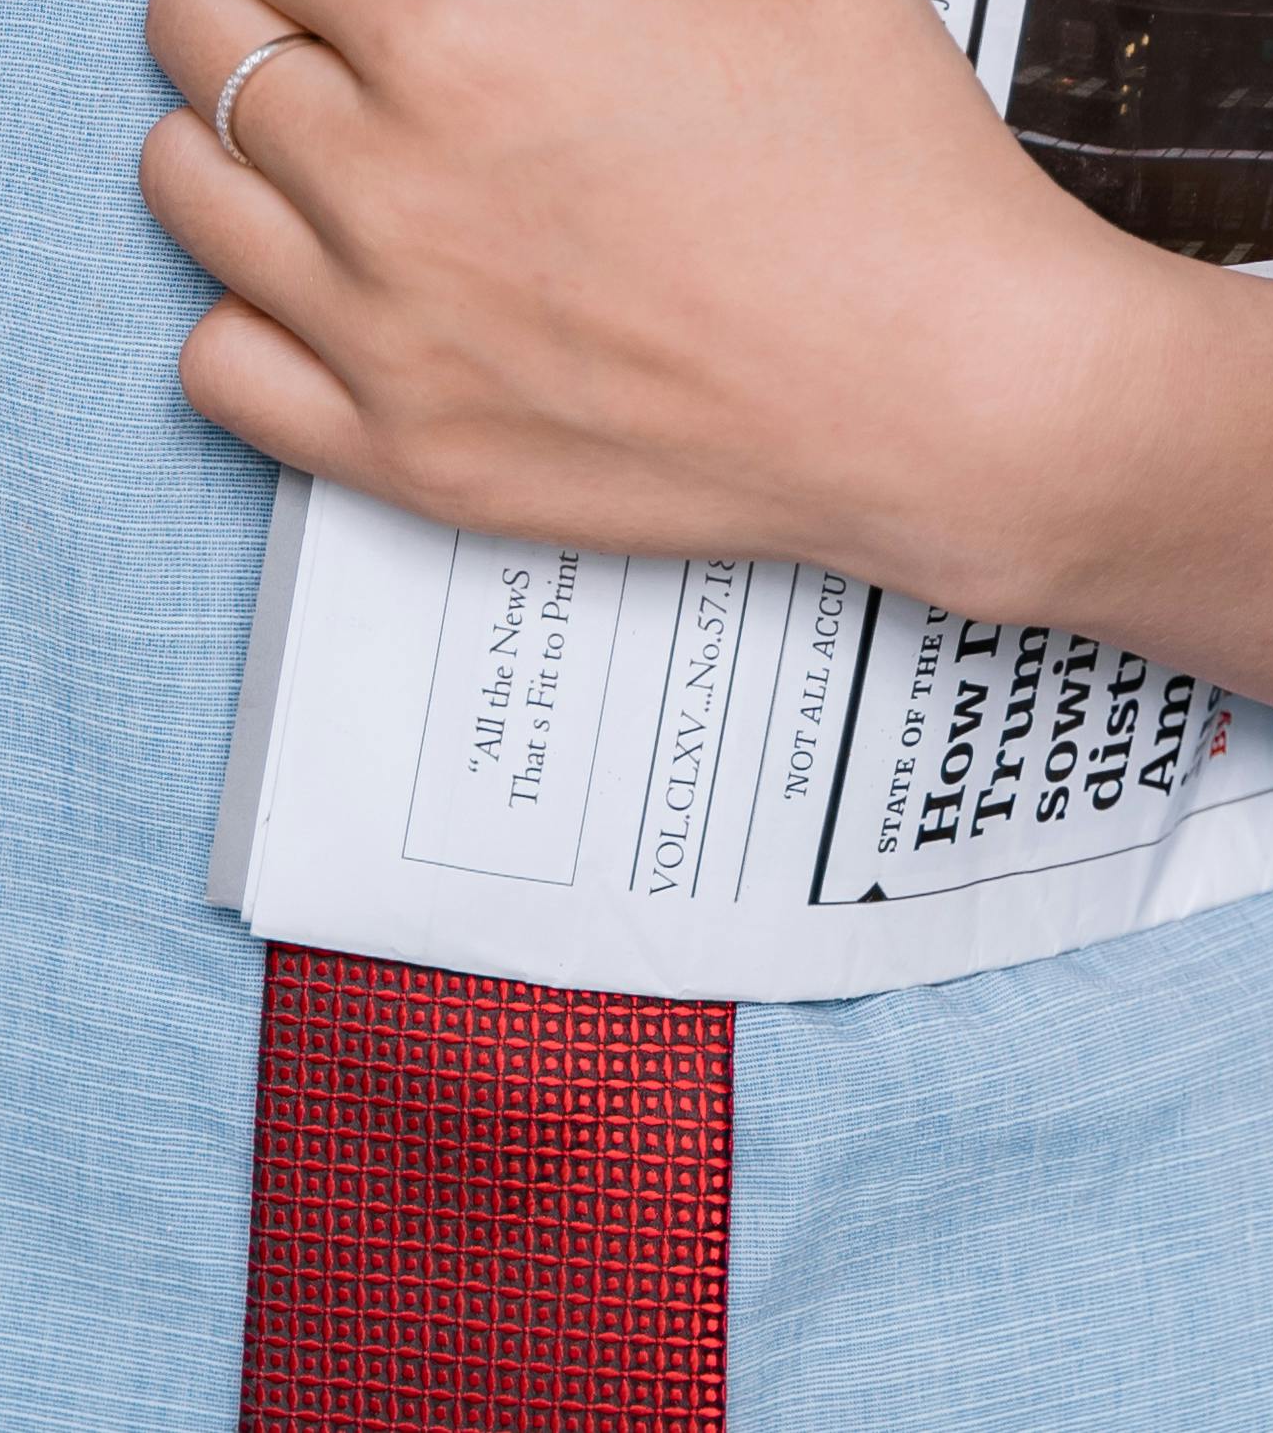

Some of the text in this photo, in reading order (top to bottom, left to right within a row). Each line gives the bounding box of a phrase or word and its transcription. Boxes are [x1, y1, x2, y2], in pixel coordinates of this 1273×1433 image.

[489, 565, 531, 657] NewS
[540, 548, 579, 623] Print
[540, 631, 566, 660] to
[909, 632, 943, 699] THE
[481, 664, 515, 707] the
[526, 668, 559, 710] Fit
[799, 666, 831, 725] ALL
[901, 707, 926, 746] OF
[1137, 672, 1196, 796] Am
[912, 678, 989, 850] How
[877, 756, 916, 853] STATE
